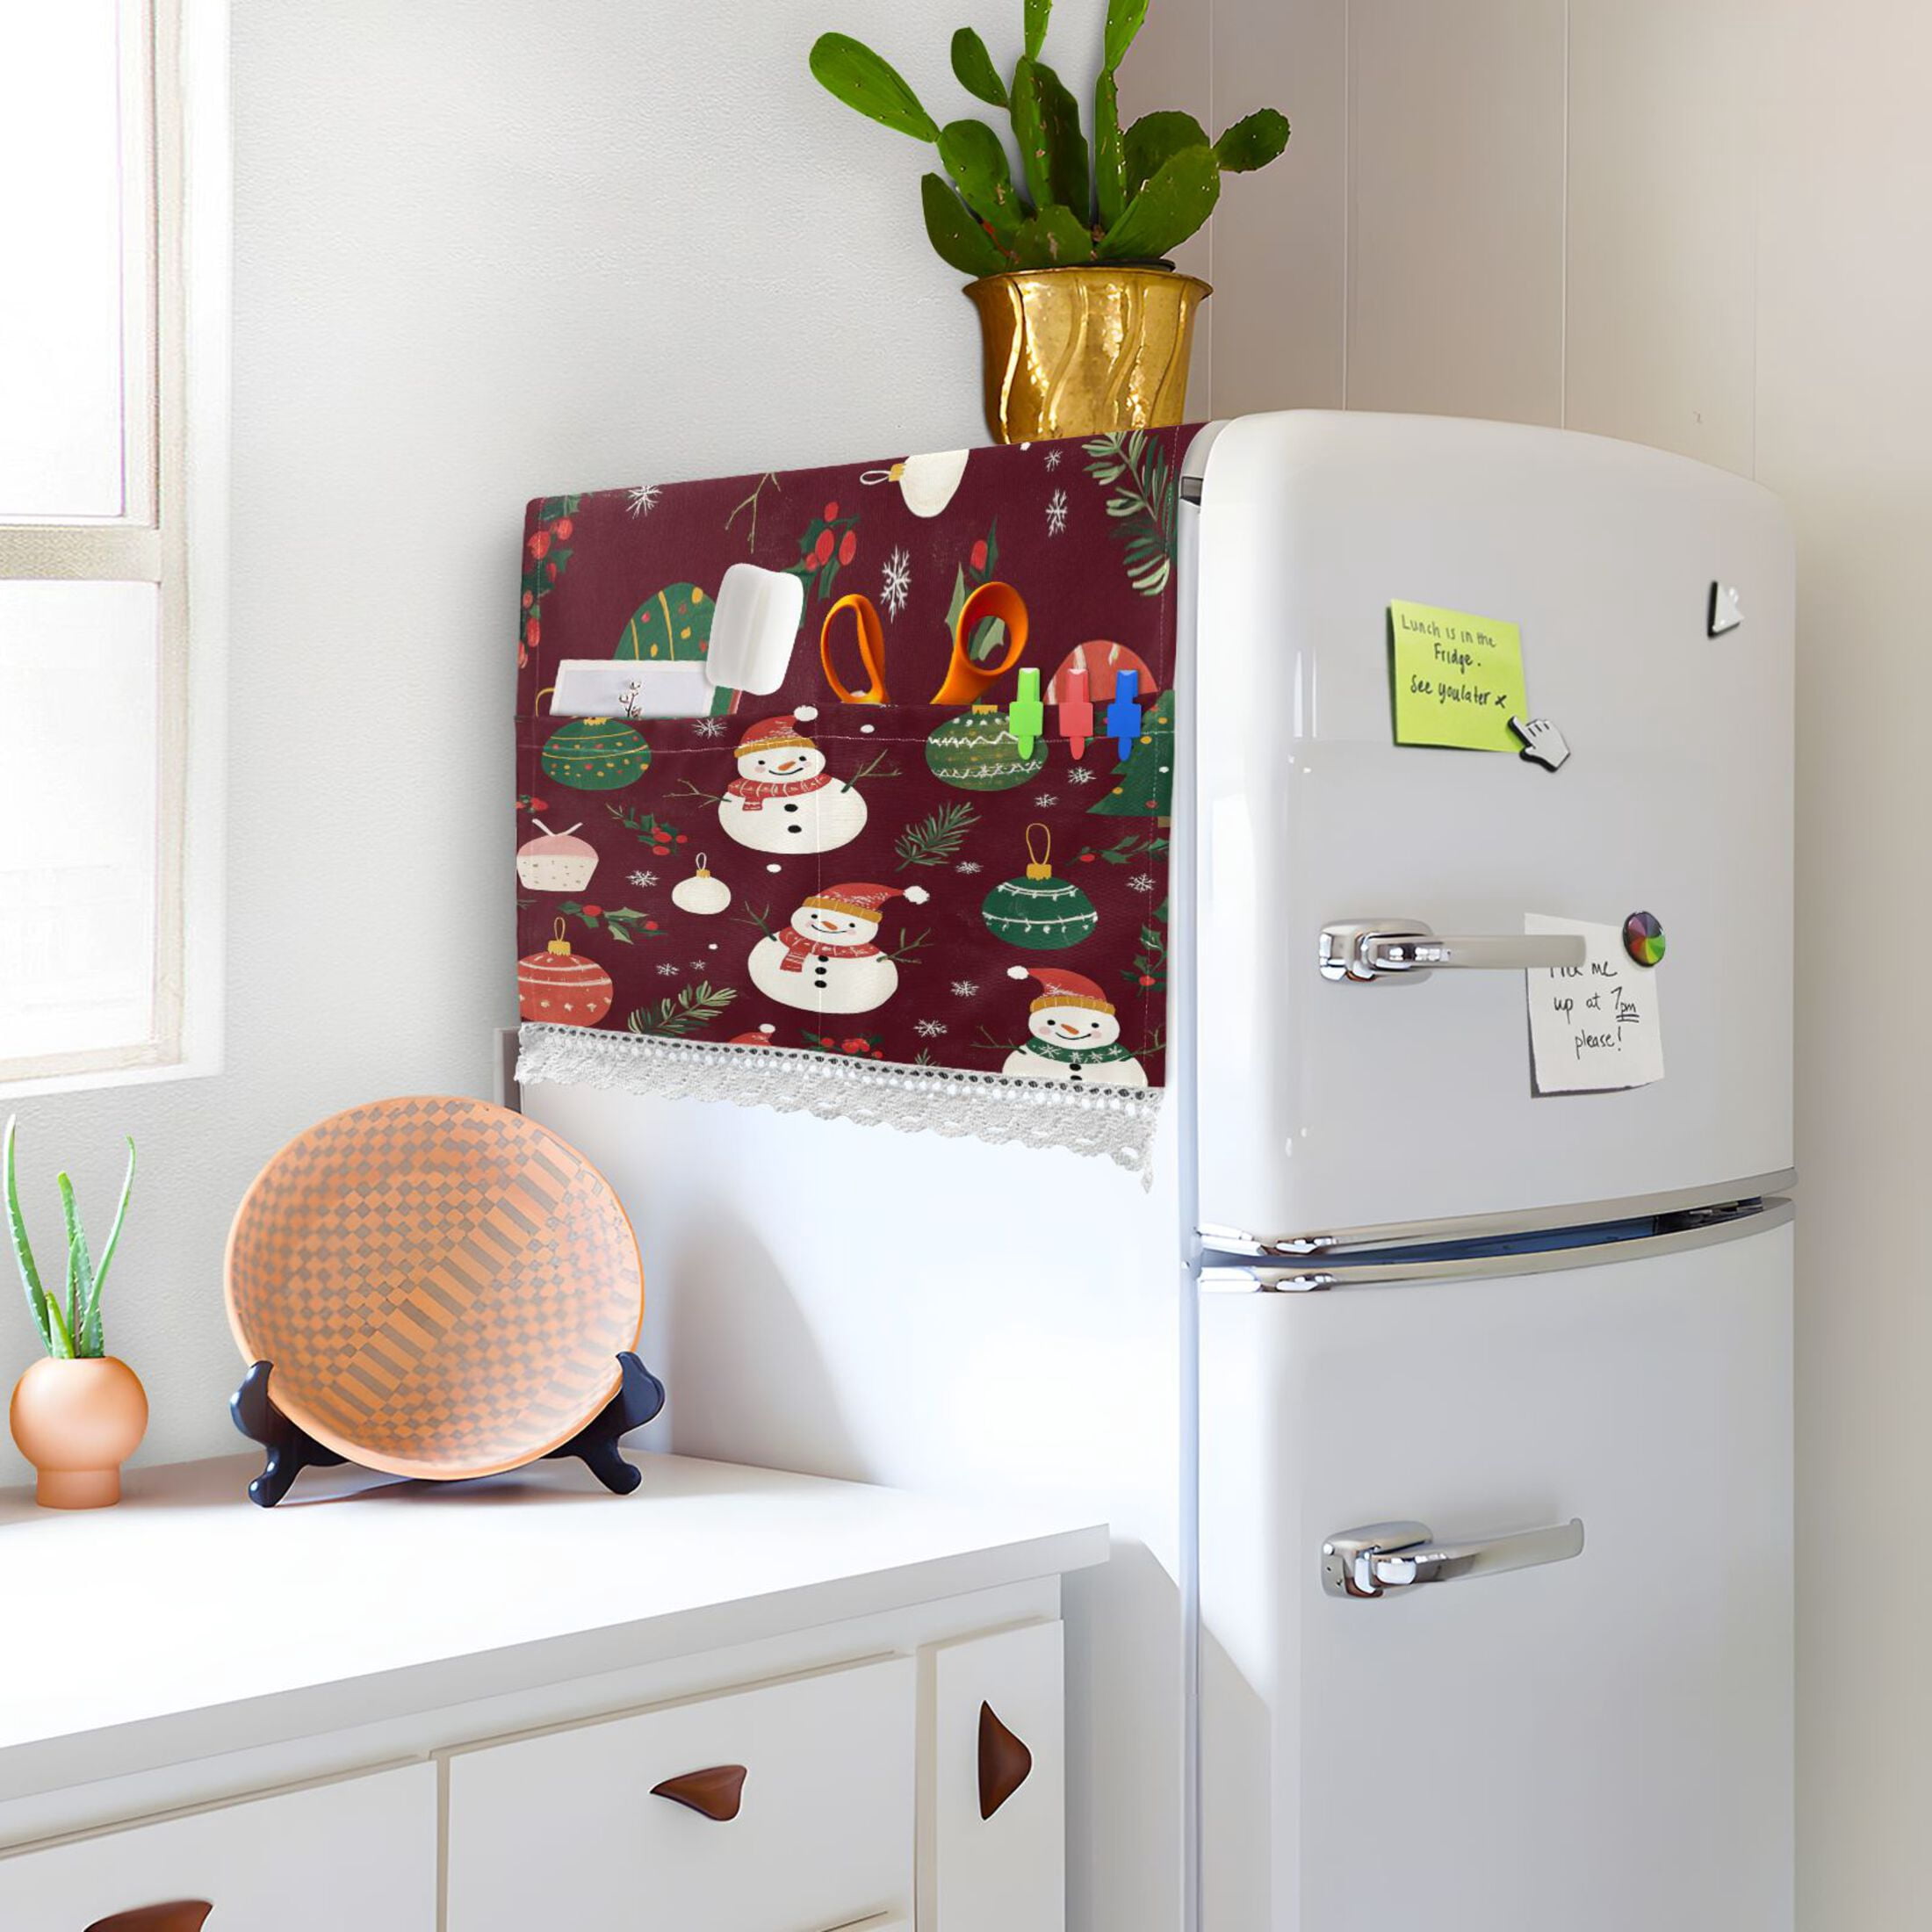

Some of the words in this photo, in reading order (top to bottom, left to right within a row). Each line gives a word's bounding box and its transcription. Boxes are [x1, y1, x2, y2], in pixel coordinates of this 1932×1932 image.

[1401, 613, 1441, 639] Lunch
[1460, 631, 1474, 644] in
[1476, 631, 1496, 648] the
[1409, 674, 1433, 696] See
[1553, 996, 1575, 1025] up
[1585, 992, 1602, 1012] at
[1574, 1025, 1622, 1061] please!
